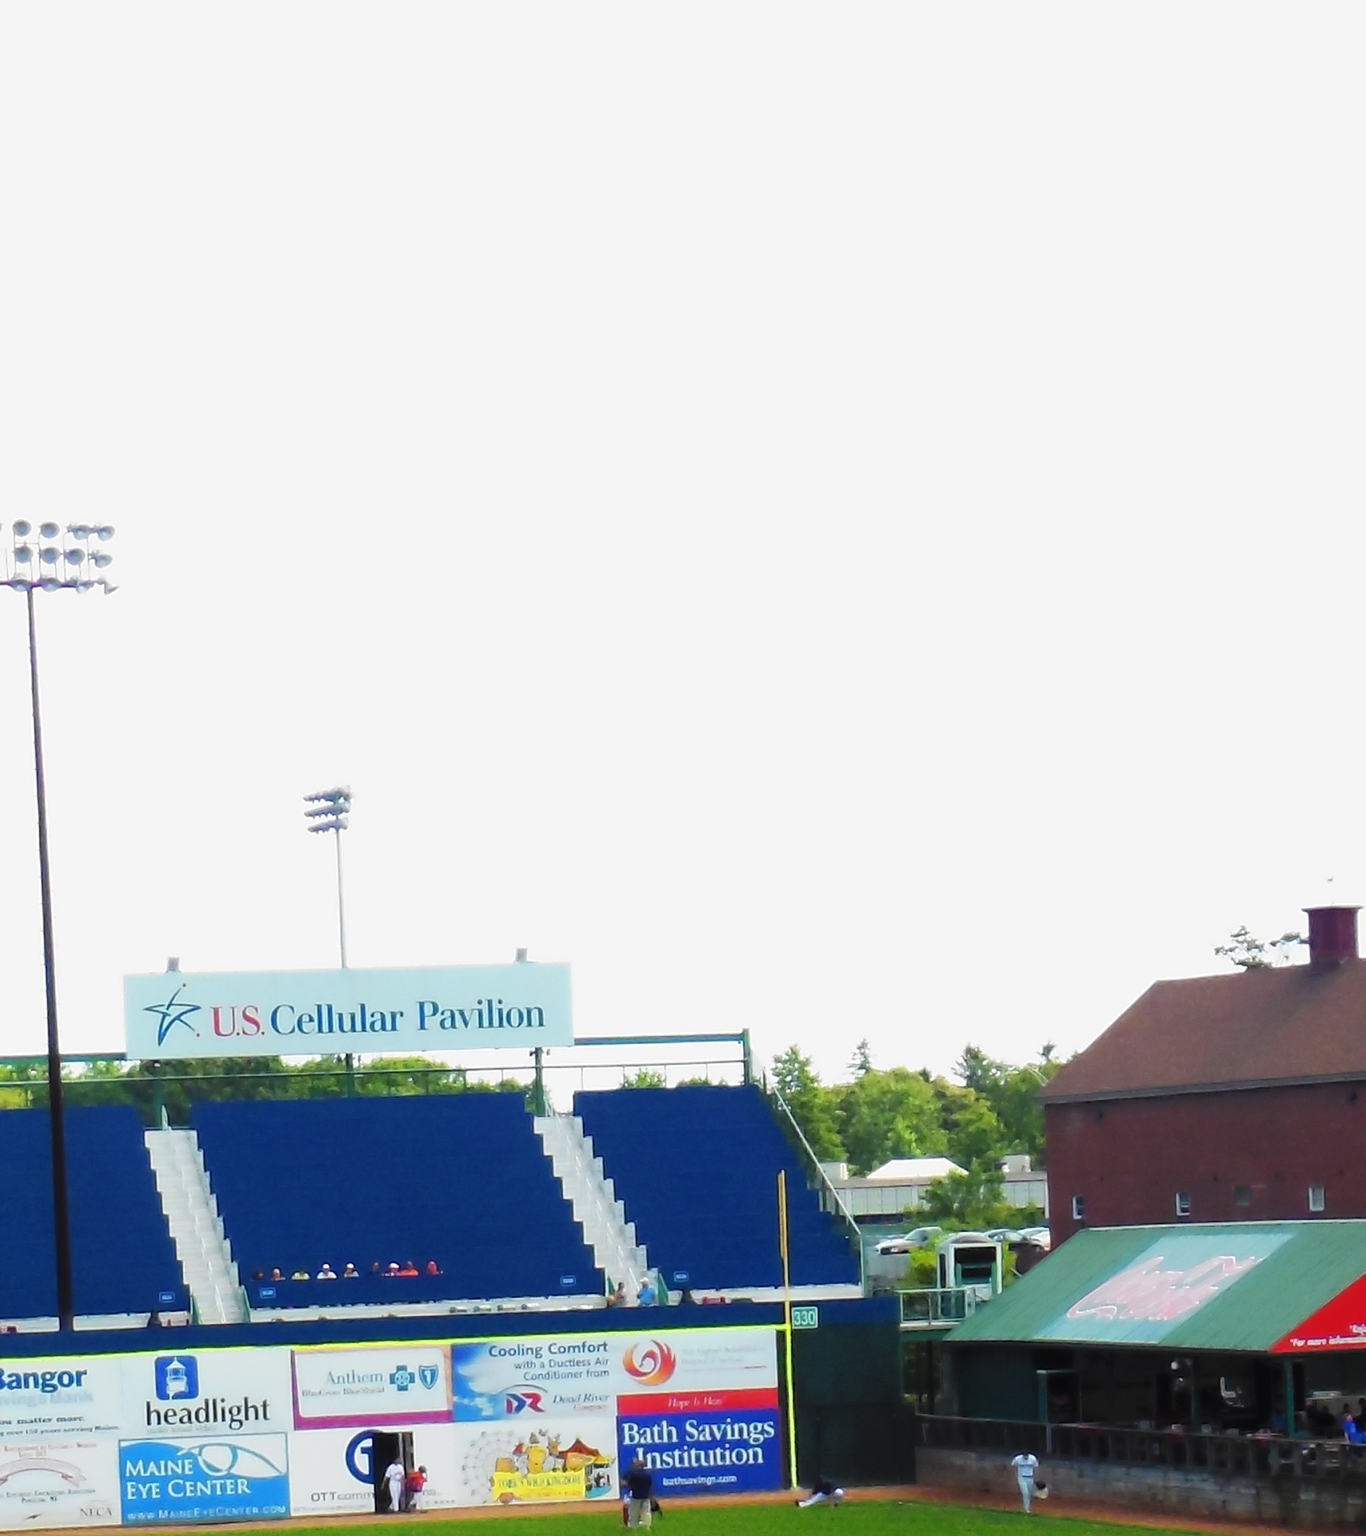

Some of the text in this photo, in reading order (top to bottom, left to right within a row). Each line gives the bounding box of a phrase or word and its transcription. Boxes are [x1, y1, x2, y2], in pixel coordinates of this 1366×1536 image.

[212, 998, 545, 1037] U.S. Cellular Pavilion
[793, 1312, 817, 1326] 330
[488, 1341, 609, 1359] Cooling Comfort
[514, 1357, 609, 1370] with a Ductless Air
[326, 1369, 384, 1384] Anthem
[523, 1369, 609, 1381] Conditioner from
[146, 1396, 271, 1431] headlight
[622, 1417, 775, 1445] Bath Savings
[635, 1443, 764, 1471] Institution
[127, 1478, 251, 1500] EYE CENTER
